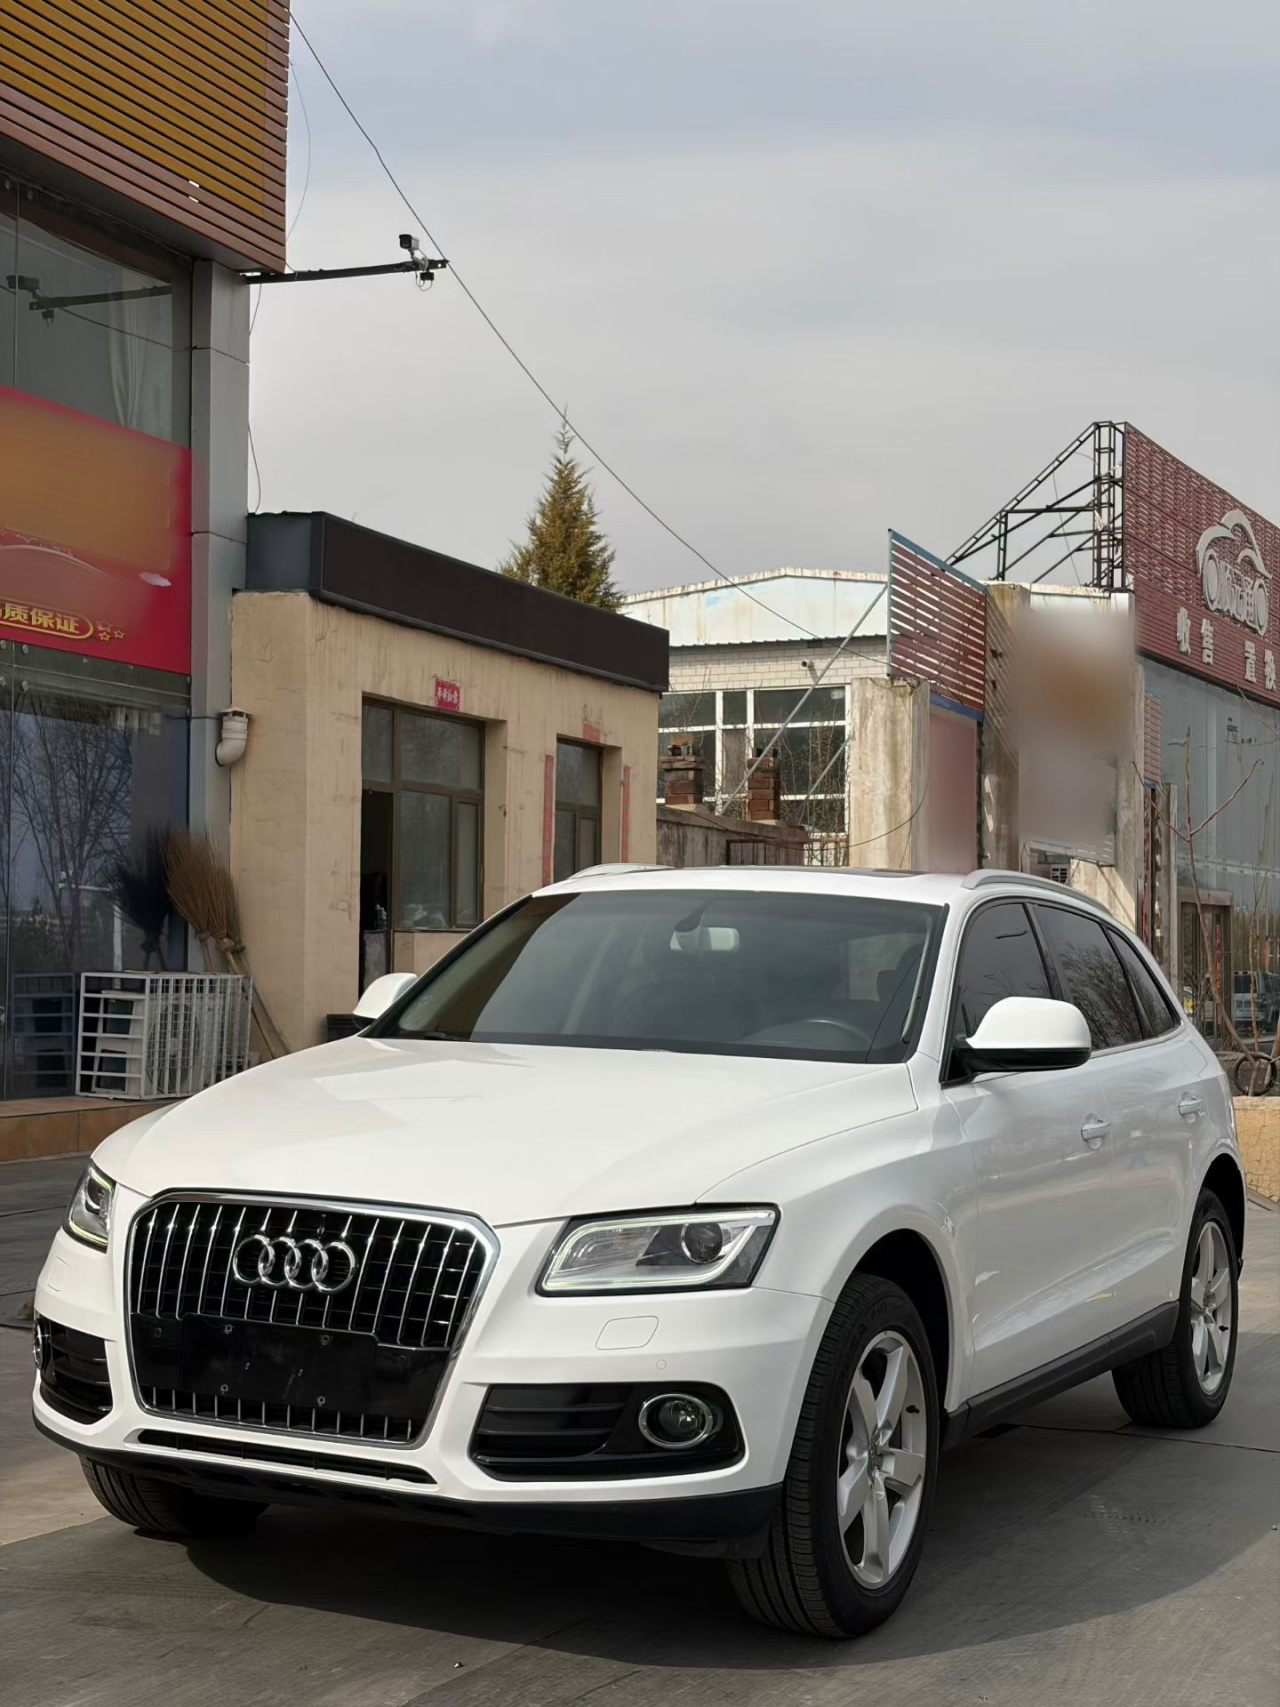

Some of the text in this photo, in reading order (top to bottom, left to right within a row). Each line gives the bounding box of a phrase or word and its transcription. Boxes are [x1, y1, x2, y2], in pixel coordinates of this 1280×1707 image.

[0, 603, 79, 634] 质保证
[1244, 640, 1276, 692] 置换
